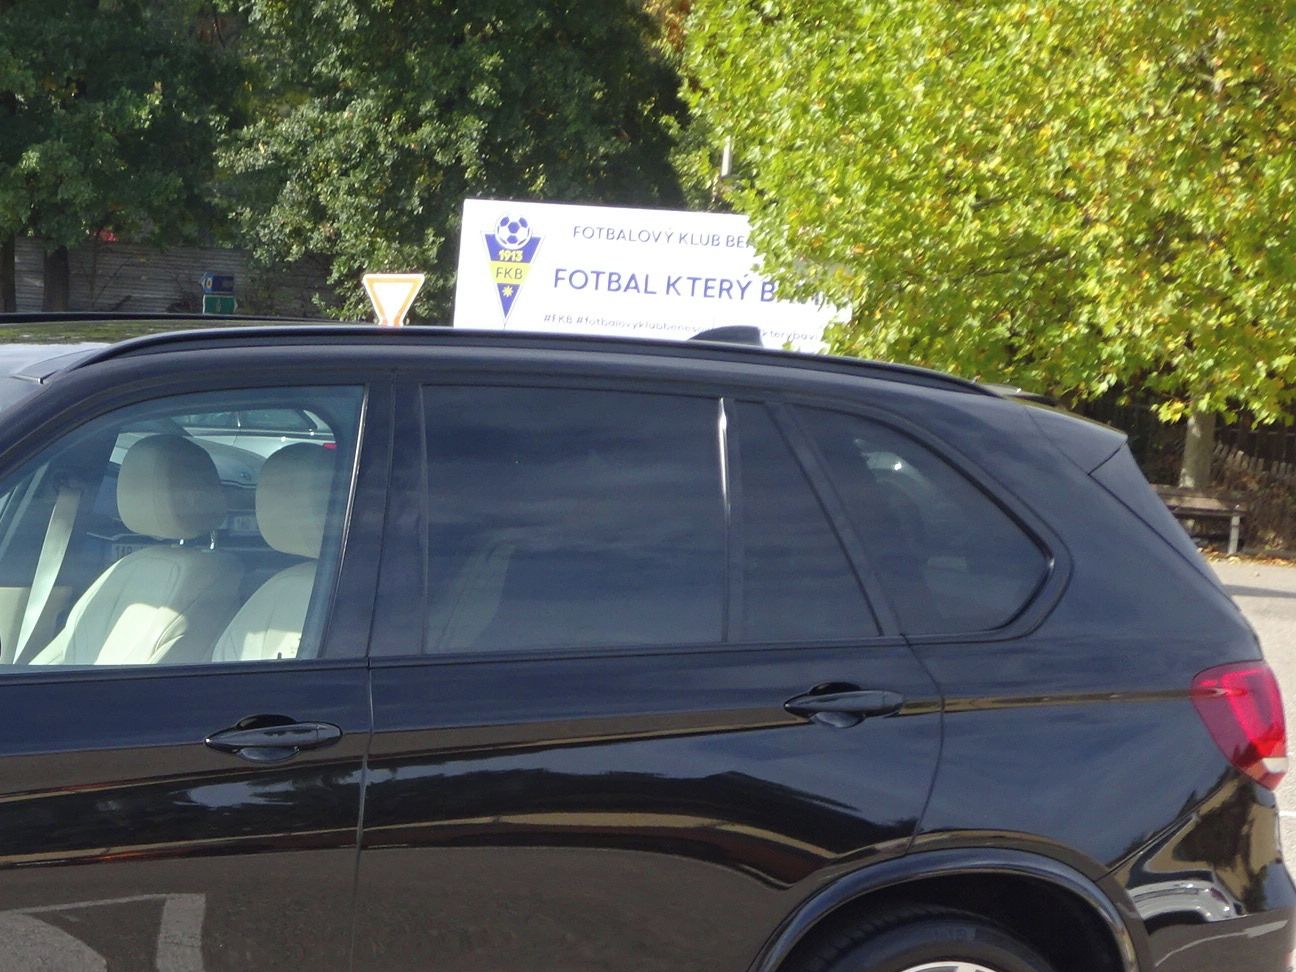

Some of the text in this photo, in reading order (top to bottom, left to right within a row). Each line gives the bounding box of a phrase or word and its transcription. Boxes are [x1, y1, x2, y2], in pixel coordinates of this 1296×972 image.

[573, 225, 674, 243] FOTBALOVÝ
[679, 232, 721, 247] KLUB
[498, 249, 524, 262] 1913
[495, 267, 524, 280] FKB
[553, 268, 657, 295] FOTBAL
[665, 273, 753, 301] KTERÝ
